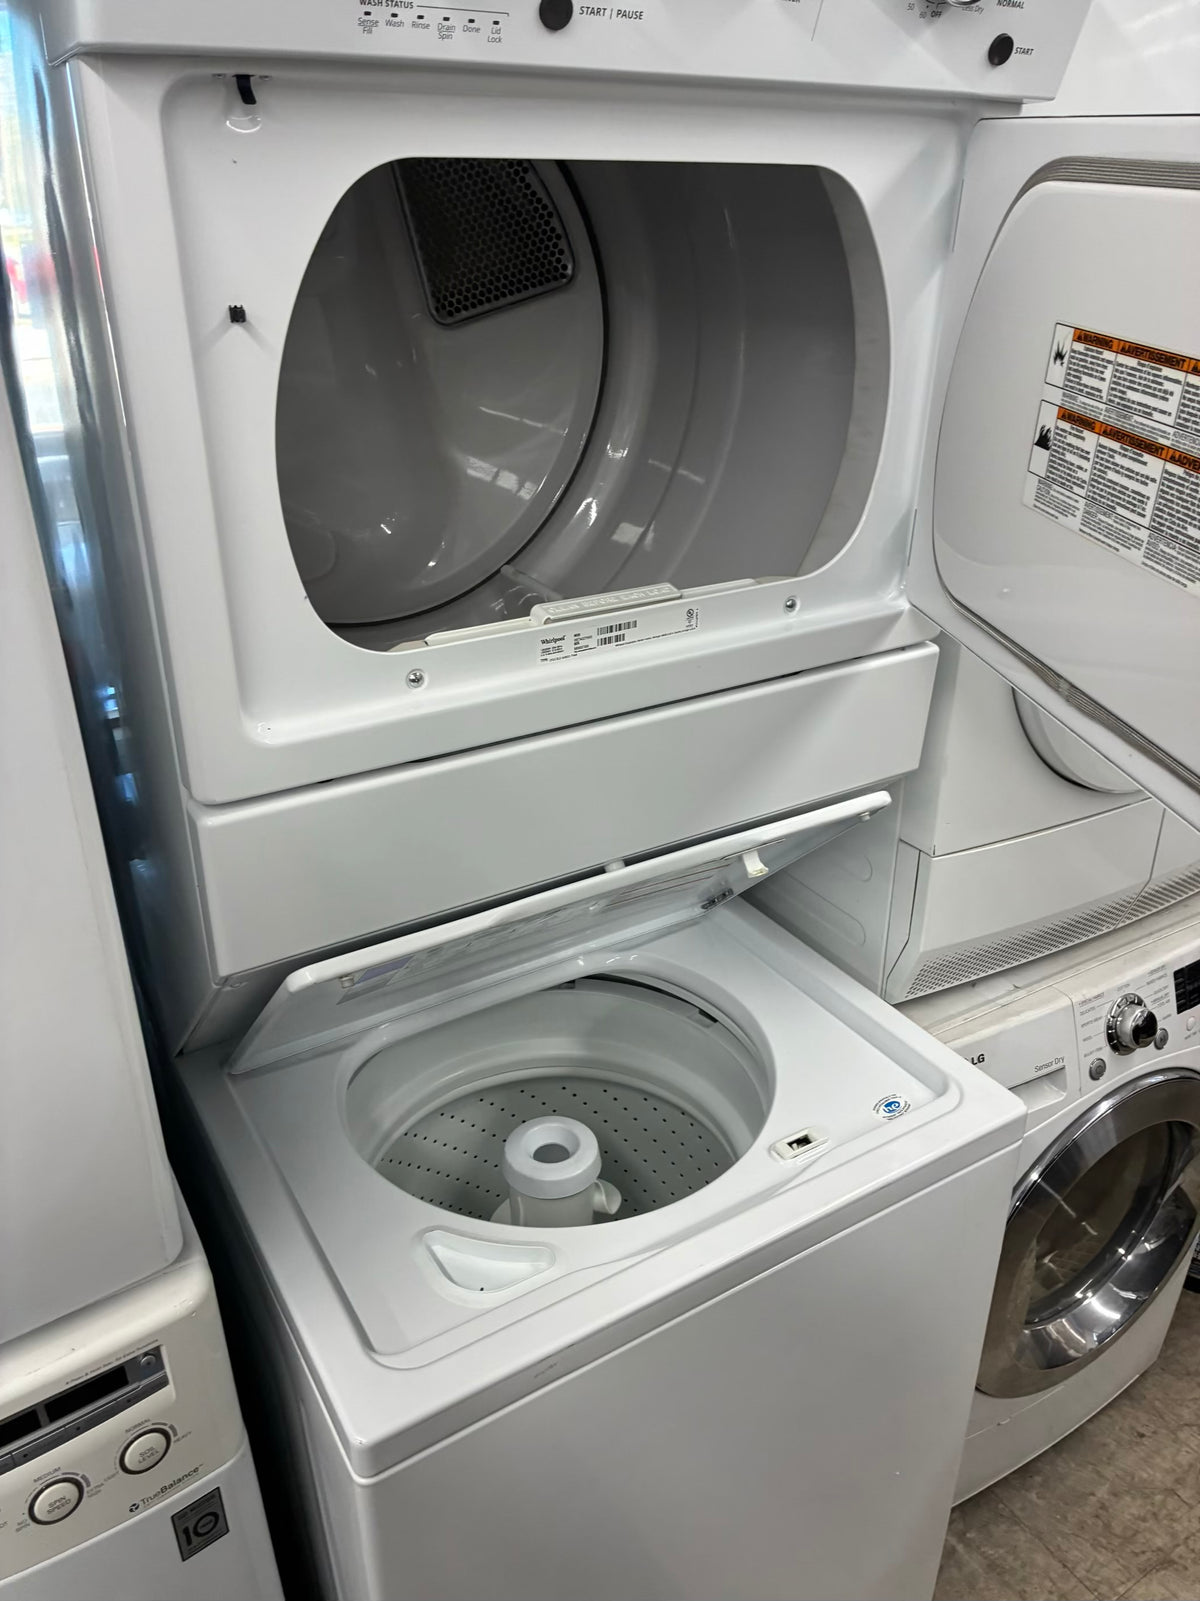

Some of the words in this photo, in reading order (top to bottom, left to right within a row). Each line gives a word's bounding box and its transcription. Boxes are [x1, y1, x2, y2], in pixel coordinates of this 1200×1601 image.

[385, 0, 414, 9] STATUS
[996, 0, 1025, 9] NORMAL
[579, 6, 607, 17] START
[616, 9, 644, 20] PAUSE
[930, 10, 942, 18] OFF
[357, 17, 380, 27] Sense
[385, 19, 405, 28] Wash
[411, 21, 431, 30] Rinse
[437, 22, 456, 32] Drain
[462, 25, 481, 33] Done
[487, 35, 503, 43] Lock
[1014, 47, 1034, 55] START
[1083, 333, 1113, 349] WARNING
[1125, 345, 1187, 369] AVERTISSEMENT
[1107, 426, 1165, 457] AVERTISSEMENT
[541, 635, 566, 644] Whirlpool
[971, 1053, 985, 1066] LG
[1034, 1061, 1054, 1073] Sensor
[1054, 1056, 1065, 1065] Dry
[138, 1450, 160, 1464] LEVEL
